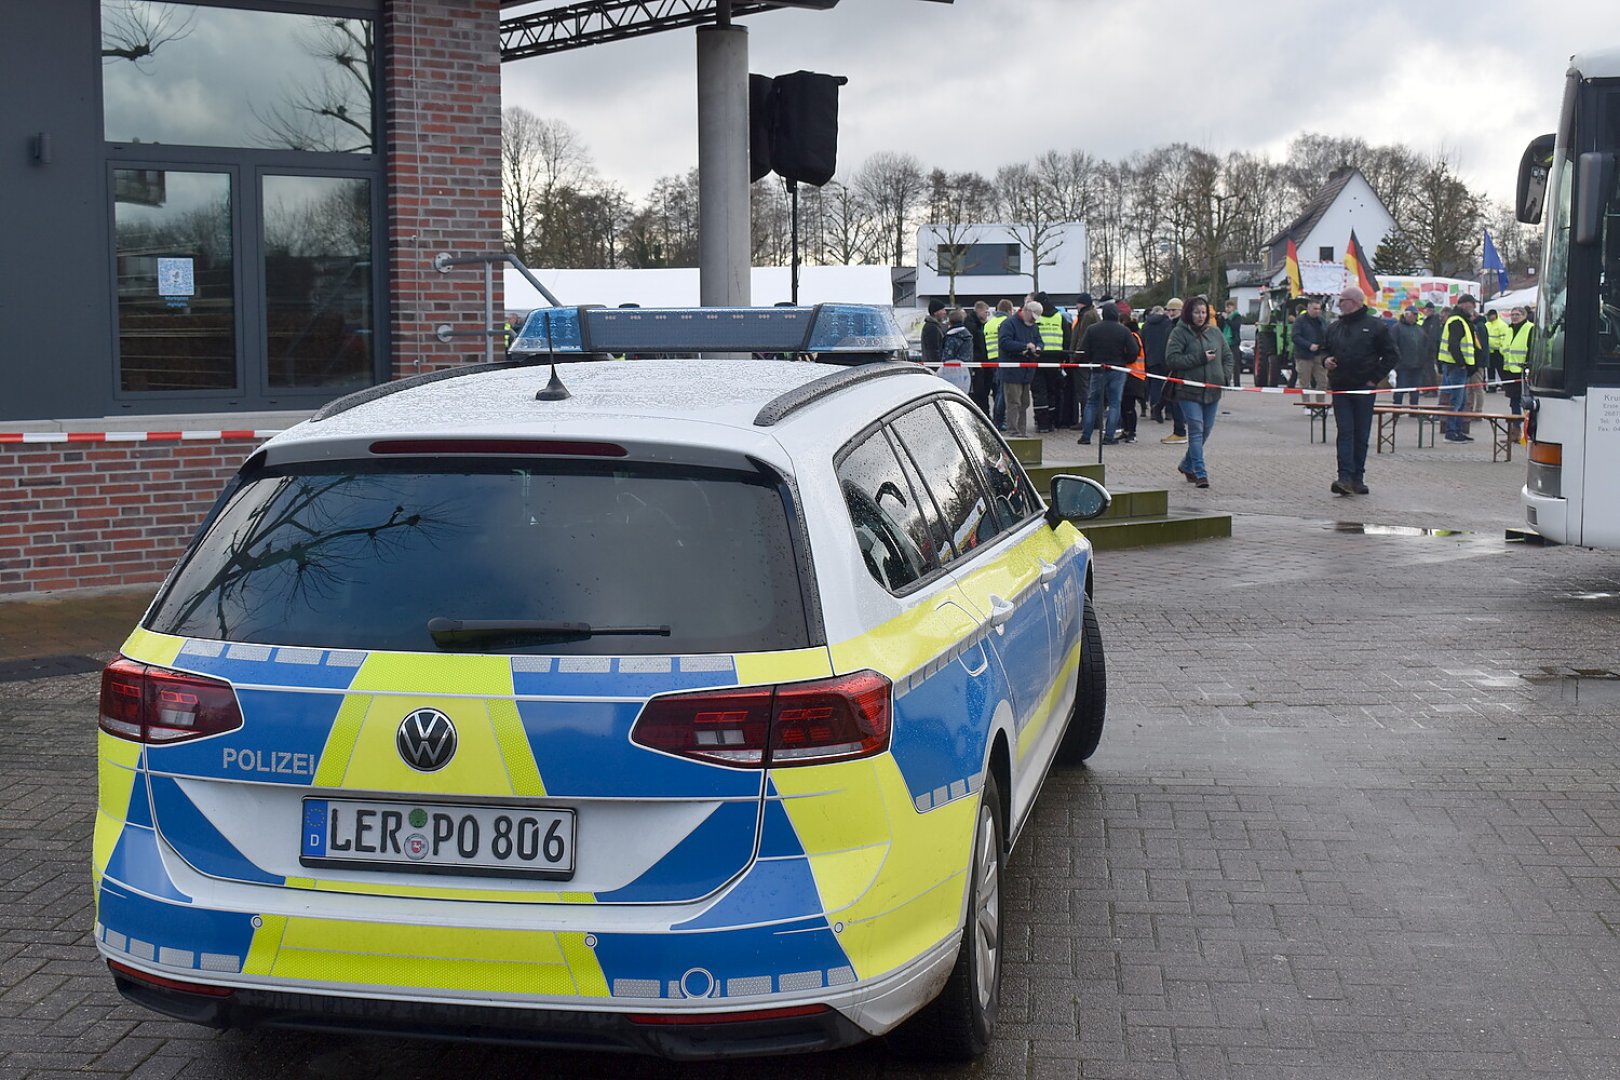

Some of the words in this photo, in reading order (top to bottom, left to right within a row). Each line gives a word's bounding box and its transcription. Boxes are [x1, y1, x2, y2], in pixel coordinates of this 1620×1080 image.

[399, 709, 456, 770] VW
[222, 747, 315, 775] POLIZEI
[310, 834, 320, 846] D
[330, 808, 402, 854] LER
[432, 813, 480, 858] PO
[491, 815, 565, 863] 806
